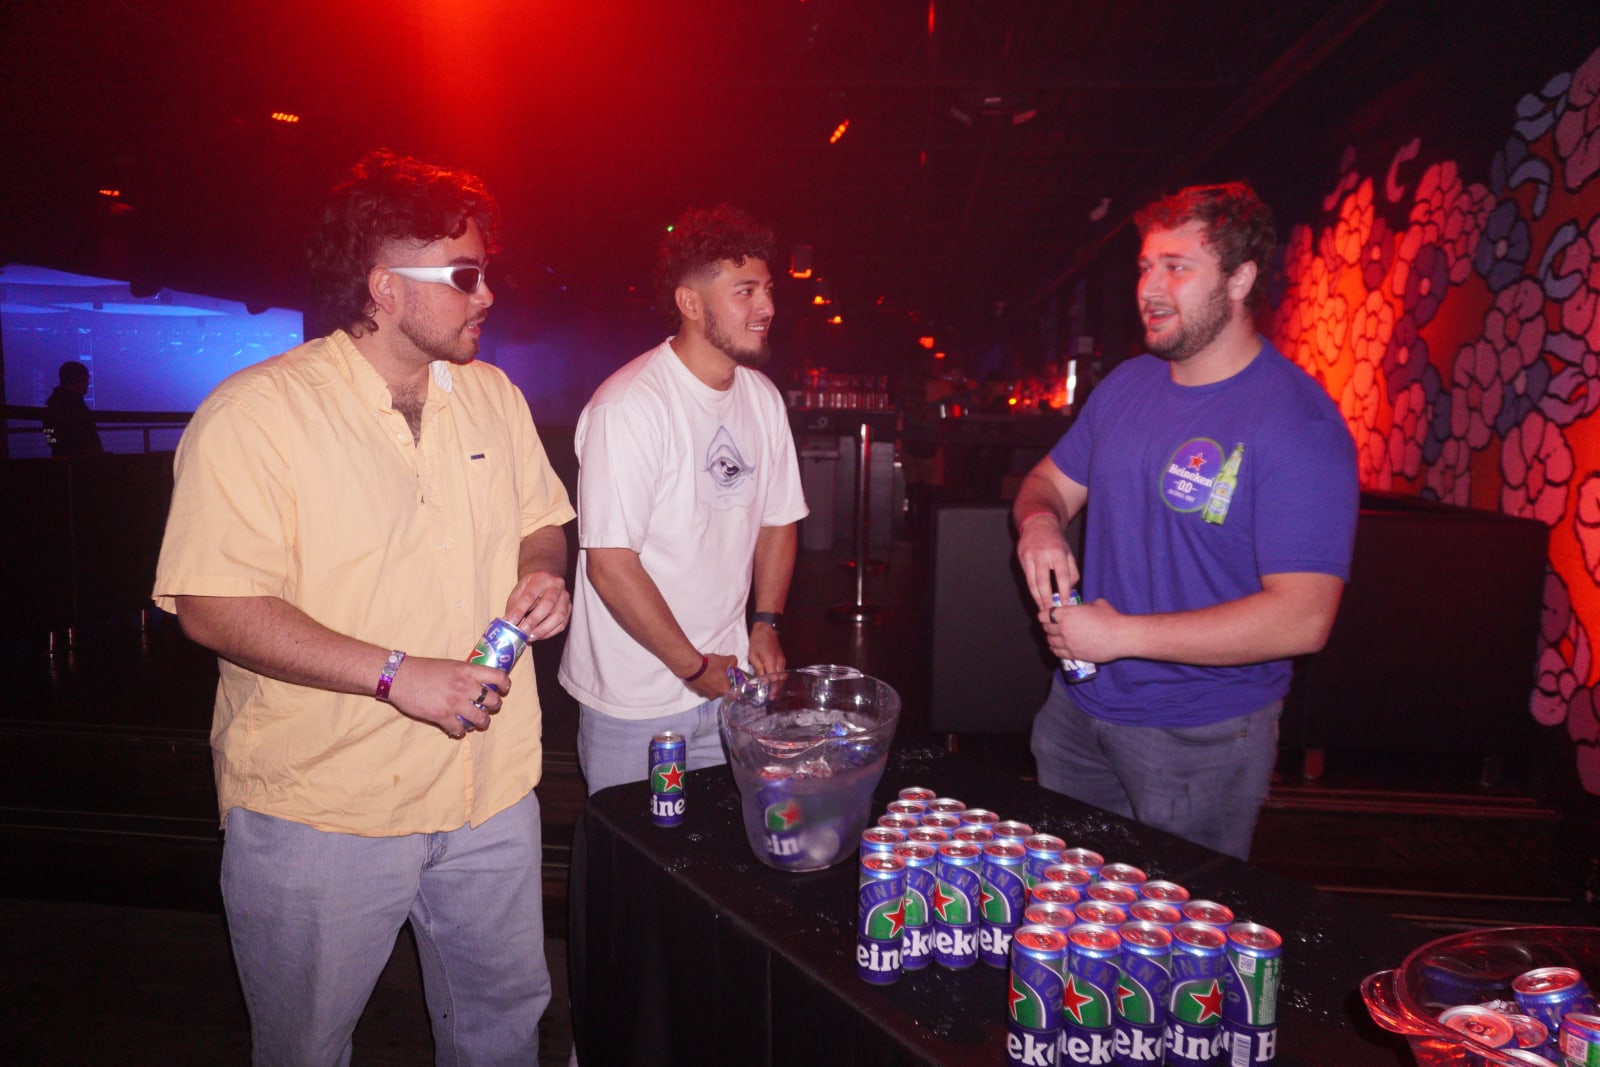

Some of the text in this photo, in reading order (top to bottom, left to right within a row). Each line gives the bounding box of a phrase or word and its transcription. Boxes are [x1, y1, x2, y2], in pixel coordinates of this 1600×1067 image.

[1168, 463, 1213, 488] Heineken
[932, 927, 977, 956] ek
[857, 942, 903, 971] ein
[1062, 1030, 1117, 1065] ek
